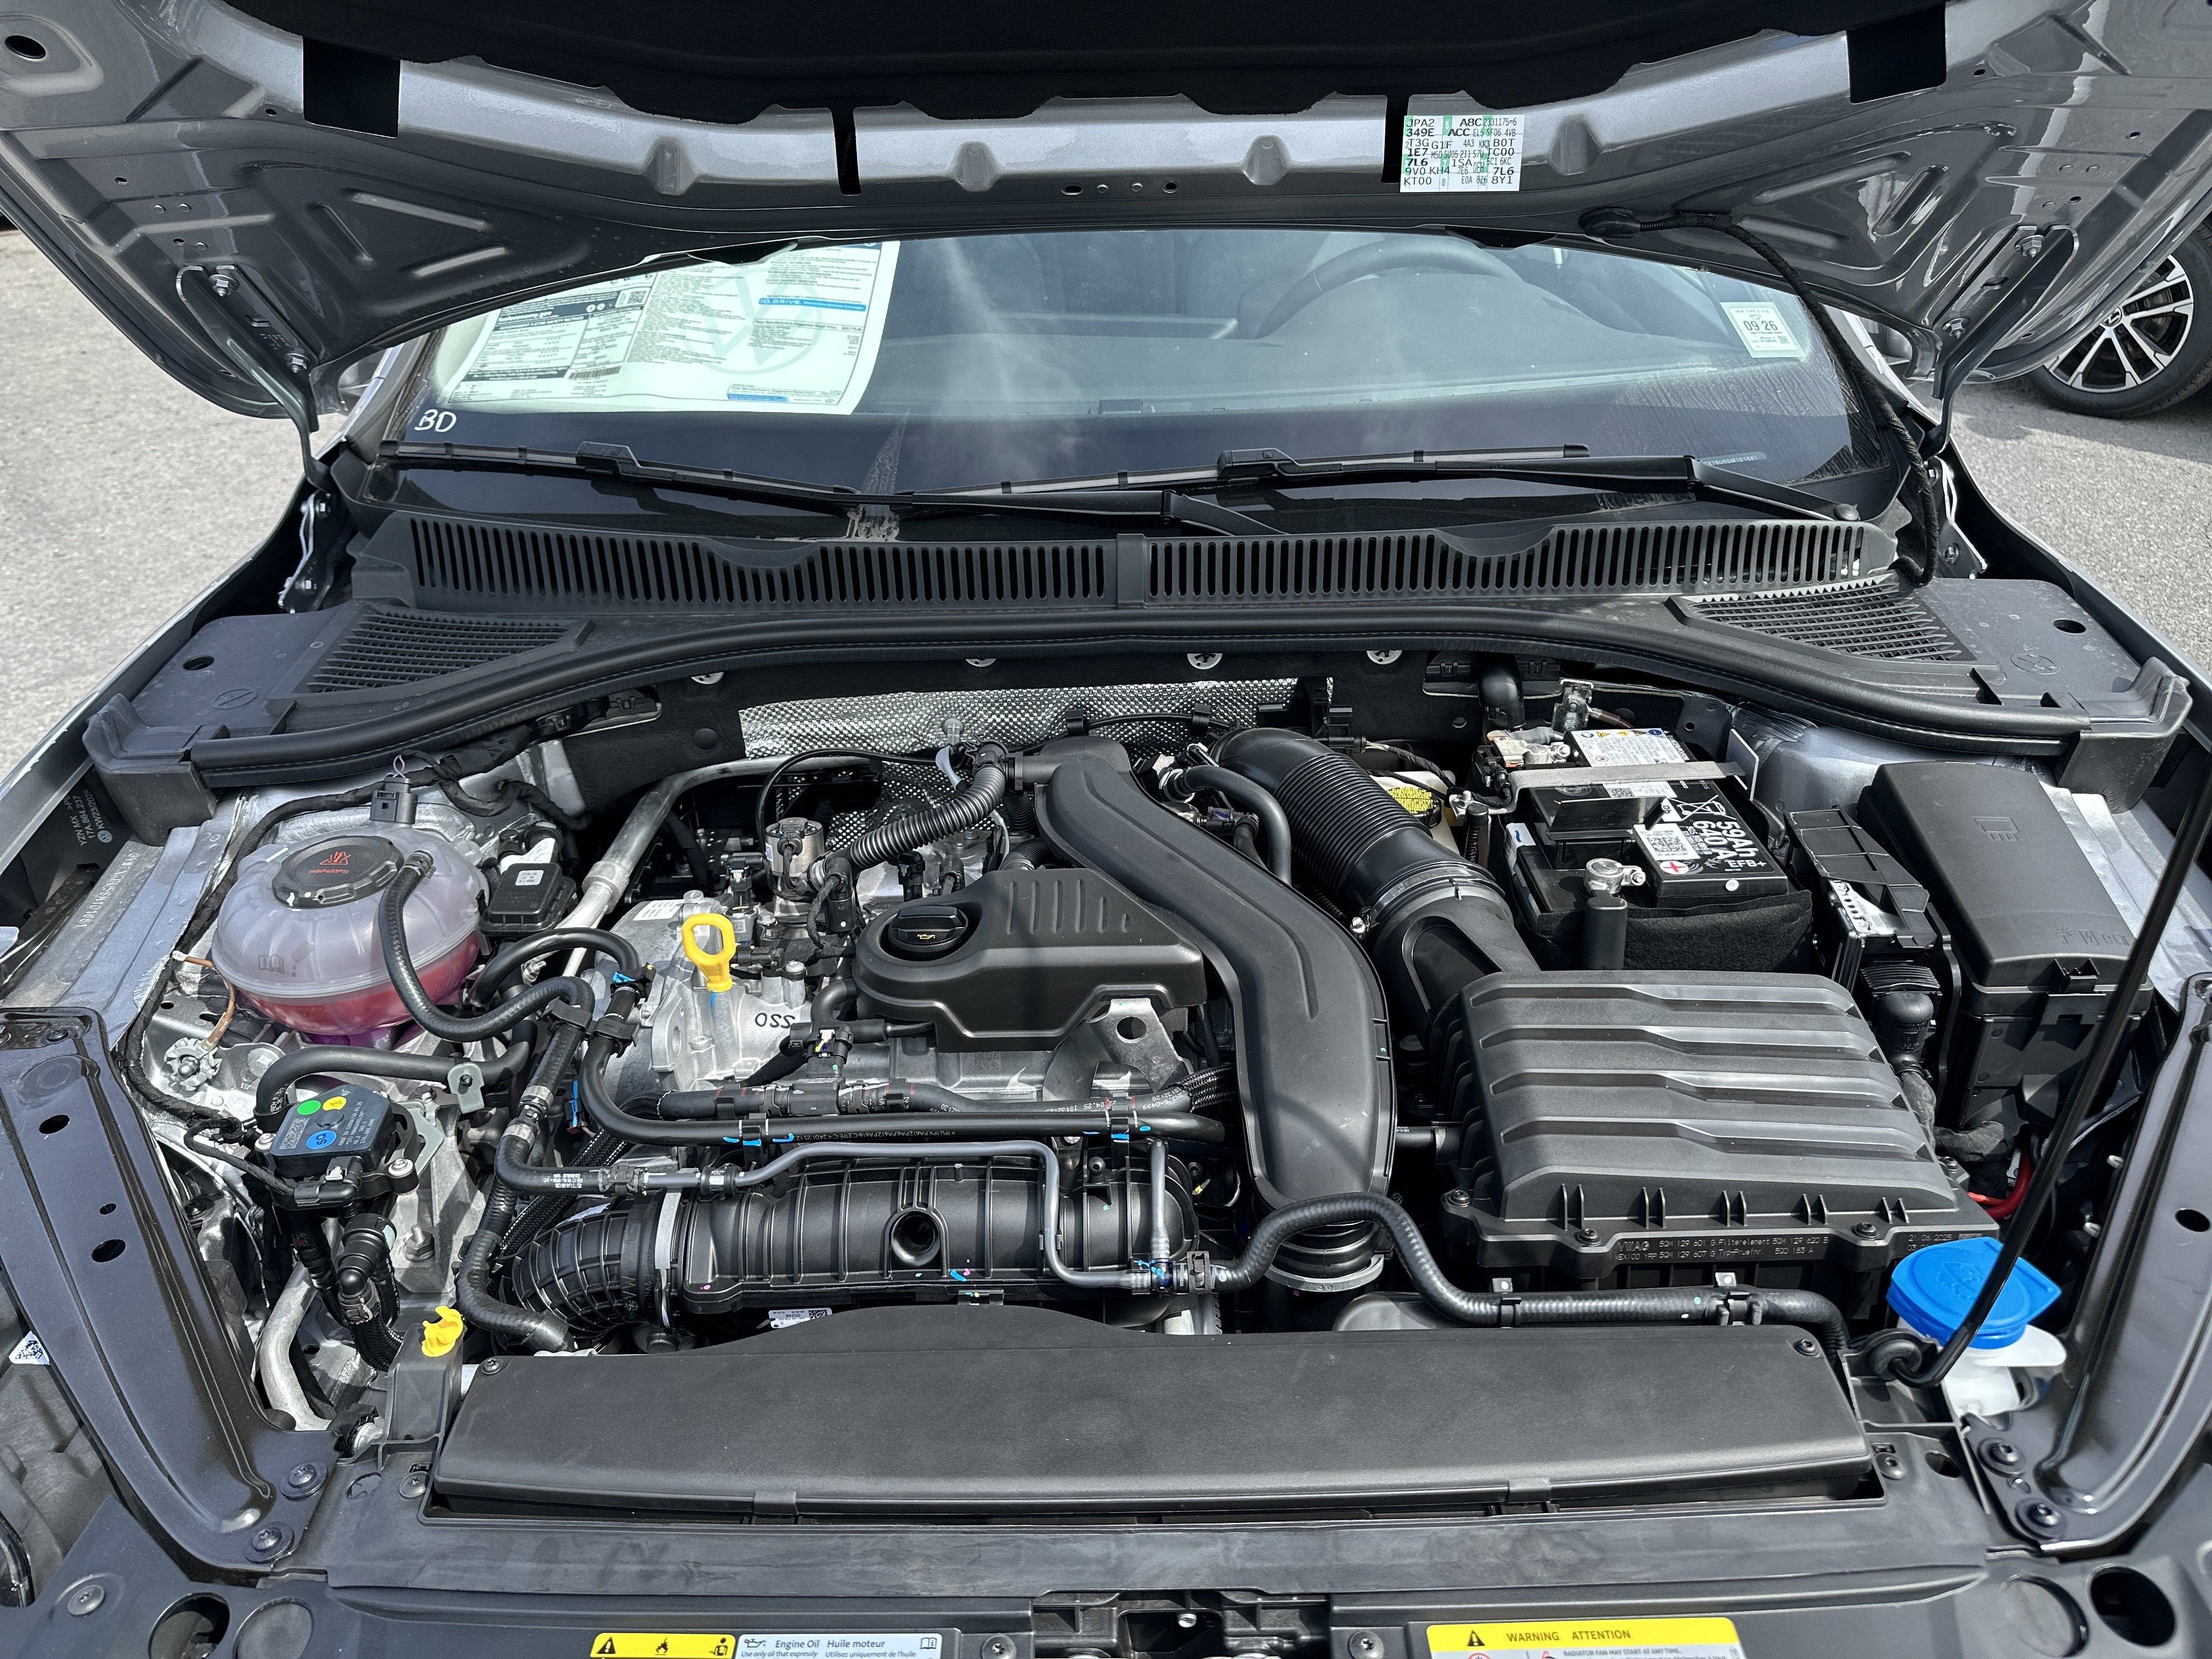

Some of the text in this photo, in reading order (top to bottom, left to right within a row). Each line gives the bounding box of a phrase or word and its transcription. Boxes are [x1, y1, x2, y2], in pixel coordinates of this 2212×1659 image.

[1406, 128, 1435, 137] 349E
[1408, 138, 1429, 146] T3G
[1431, 140, 1453, 149] G1F
[1463, 139, 1474, 147] 4A3
[1408, 148, 1428, 156] 1E7
[1407, 158, 1428, 166] 7L6
[1452, 159, 1472, 167] 1SA
[1430, 166, 1450, 174] KH4
[1493, 167, 1514, 175] 7L6
[1404, 176, 1432, 185] KT00
[1492, 176, 1513, 184] 8Y1
[414, 409, 457, 432] BD
[70, 815, 81, 828] MX
[75, 829, 88, 846] YZN
[1692, 820, 1728, 845] 640
[1711, 848, 1738, 860] A
[1716, 821, 1759, 857] 59Ah
[1726, 860, 1767, 868] EFB+
[1618, 1241, 1650, 1251] VWAG
[1506, 1630, 1631, 1642] WARNING ATTENTION
[776, 1640, 805, 1650] Engine
